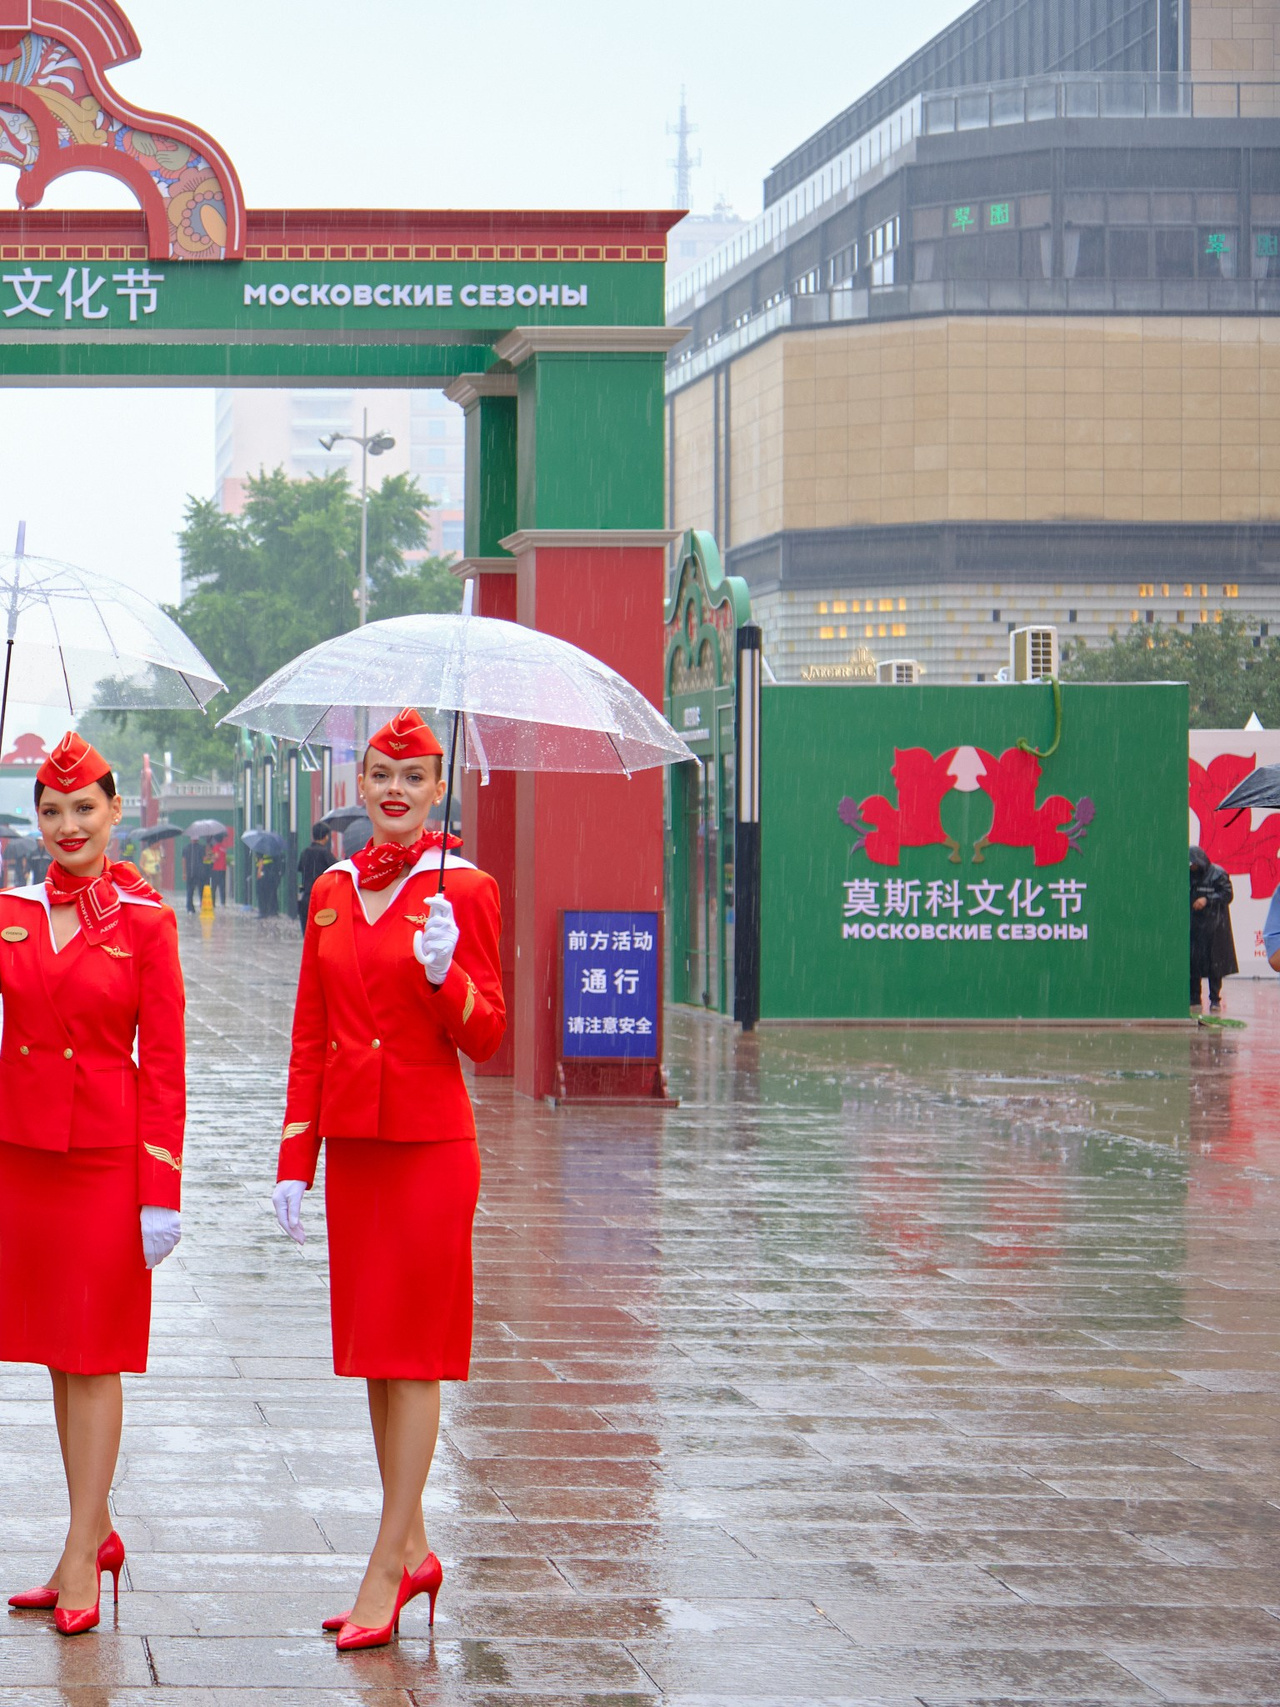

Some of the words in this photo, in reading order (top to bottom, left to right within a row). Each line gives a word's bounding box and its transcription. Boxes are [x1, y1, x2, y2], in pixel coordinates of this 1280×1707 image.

[243, 284, 453, 306] МОСКОВСКИЕ
[460, 284, 588, 306] СЕЗОНЫ
[843, 878, 1087, 918] 莫斯科文化节
[568, 930, 653, 951] 前方活动
[843, 923, 992, 940] МОСКОВСКИЕ
[997, 923, 1088, 940] СЕЗОНЫ
[581, 968, 640, 994] 通行
[567, 1016, 652, 1034] 请注意安全
